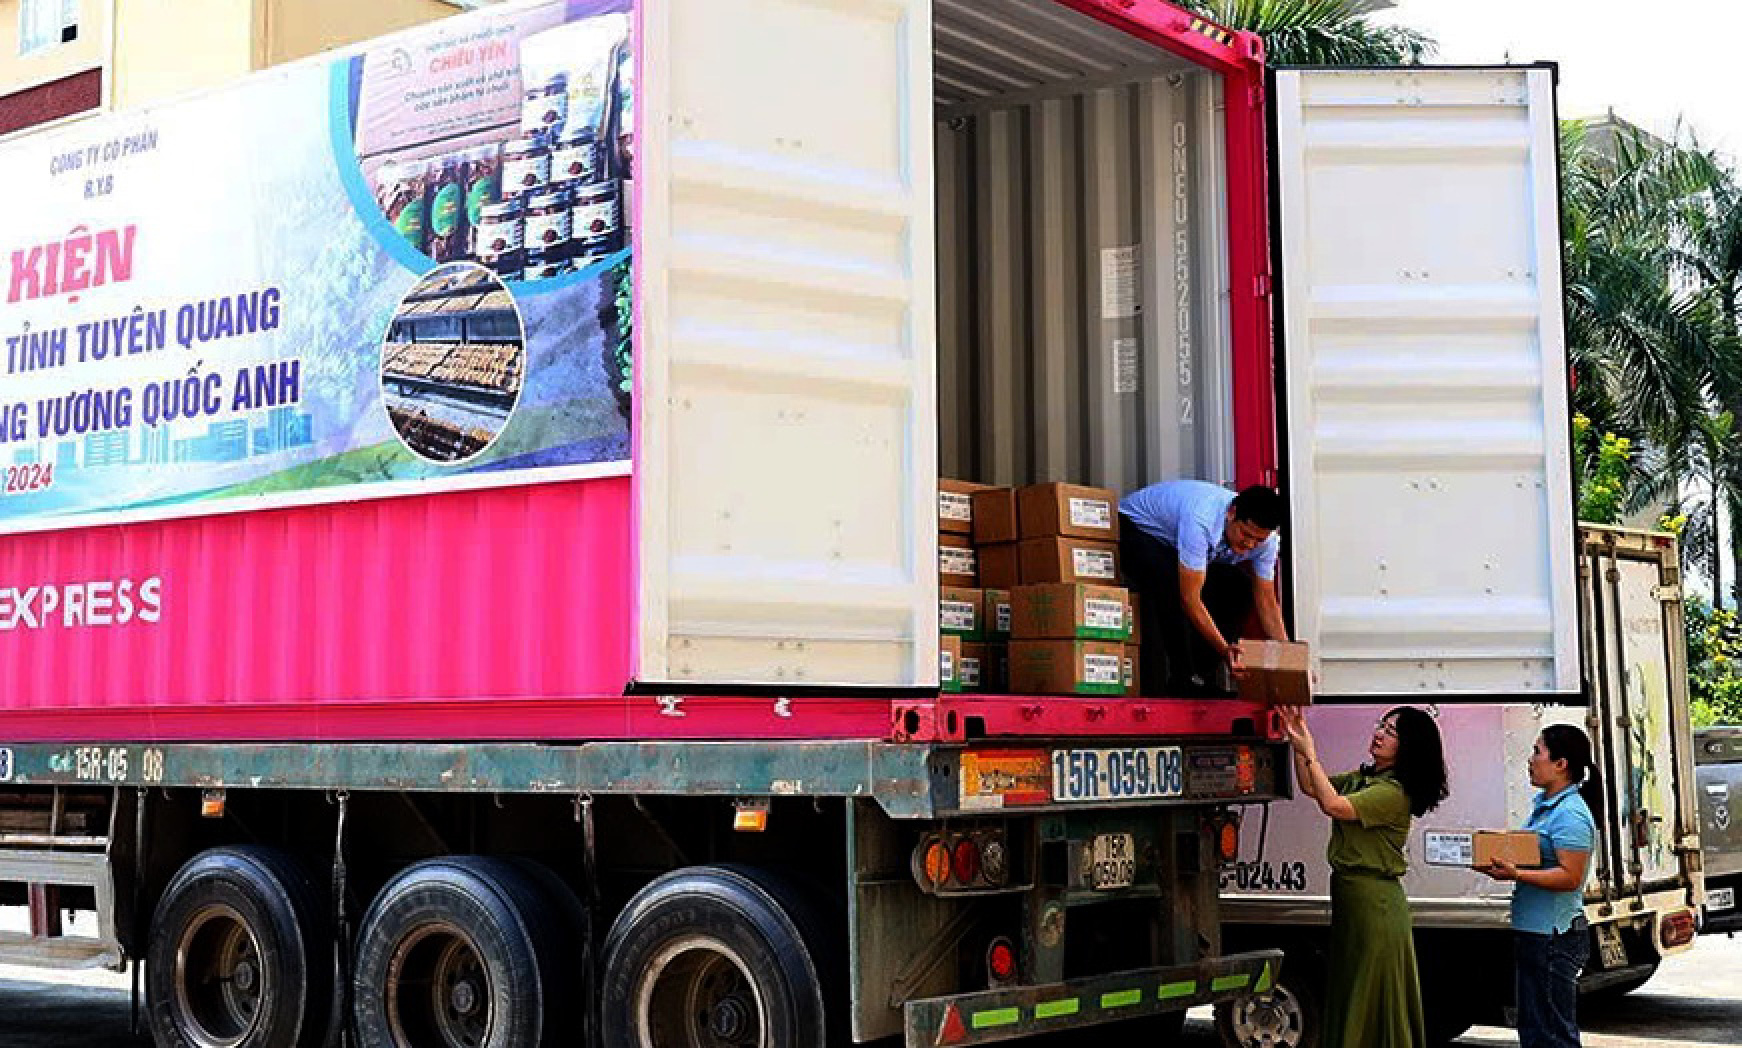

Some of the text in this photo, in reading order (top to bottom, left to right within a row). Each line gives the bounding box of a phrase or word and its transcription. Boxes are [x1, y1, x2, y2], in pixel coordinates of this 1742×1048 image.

[7, 225, 137, 304] KIỆN
[6, 287, 281, 374] TỈNH TUYÊN QUANG
[37, 387, 132, 438] VƯƠNG
[142, 359, 222, 428] QUỐC
[232, 359, 299, 411] ANH
[0, 577, 161, 629] EXPRESS
[1055, 750, 1181, 798] 15R-059.08
